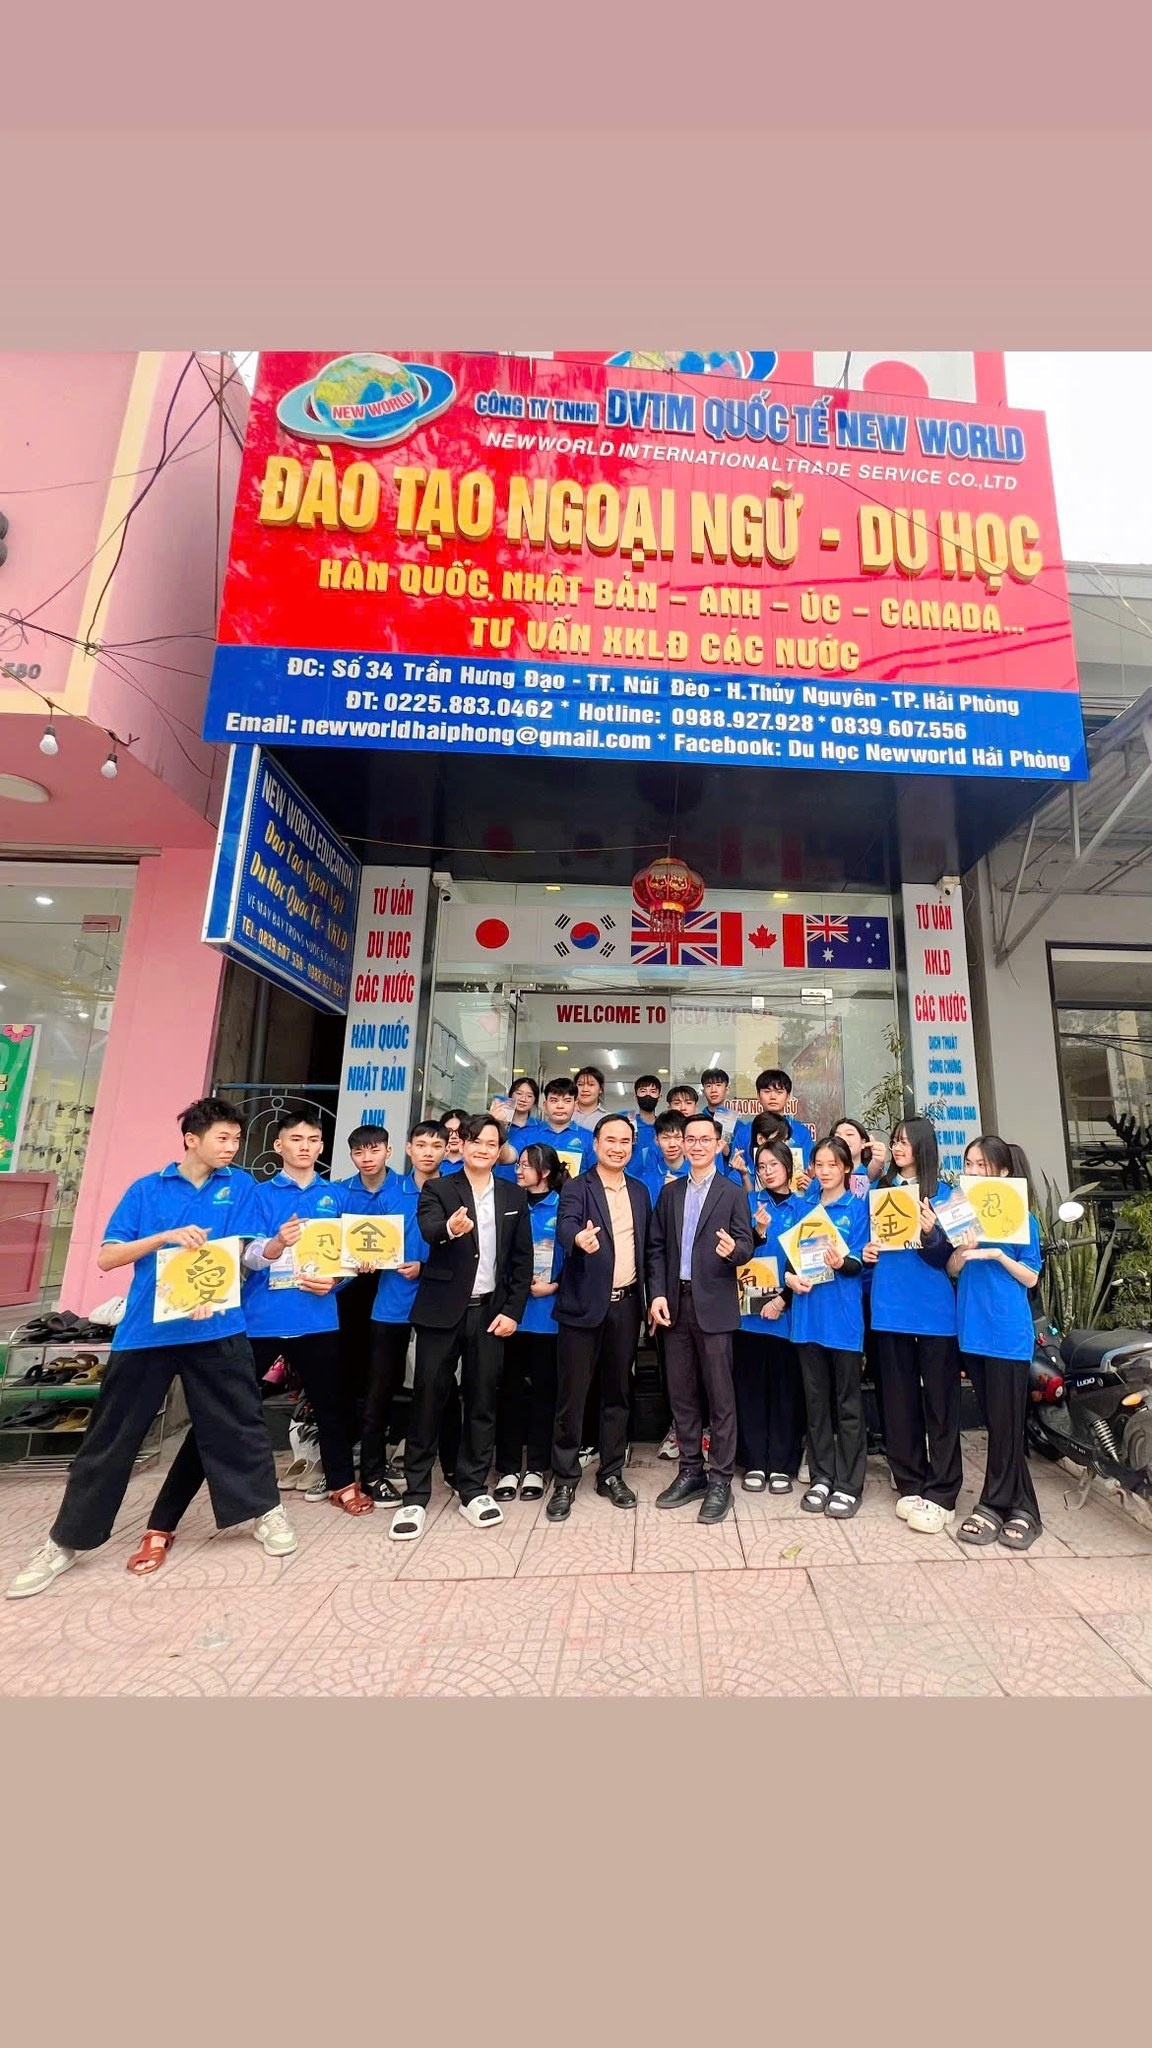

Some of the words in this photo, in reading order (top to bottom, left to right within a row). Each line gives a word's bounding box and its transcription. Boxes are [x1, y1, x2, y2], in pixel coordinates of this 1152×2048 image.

[332, 404, 367, 420] NEW
[370, 391, 414, 416] WORLD
[475, 390, 522, 418] CÔNG
[529, 397, 551, 420] TY
[554, 399, 598, 423] TNHH
[606, 386, 694, 433] DVTM
[703, 389, 788, 441] QUỐC
[792, 395, 829, 447] TẾ
[836, 409, 908, 454] NEW
[915, 414, 1026, 463] WORLD
[785, 459, 850, 478] TRADE
[859, 464, 941, 485] SERVICE
[947, 471, 1017, 491] CO.,LTD
[260, 444, 380, 533] ĐÀO
[394, 468, 495, 550] TẠO
[507, 475, 676, 572] NGOẠI
[690, 481, 804, 568] NGỮ
[820, 527, 840, 551] -
[859, 505, 930, 577] DU
[938, 511, 1043, 595] HỌC
[319, 554, 388, 592] HÀN
[400, 559, 494, 600] QUỐC,
[502, 570, 582, 610] NHẬT
[594, 572, 657, 613] BẢN
[699, 586, 761, 619] ANH
[801, 587, 840, 623] ÚC
[880, 599, 1024, 634] CANADA...
[470, 616, 515, 649] TƯ
[527, 613, 590, 654] VẤN
[603, 626, 688, 662] XKLĐ
[701, 628, 763, 666] CÁC
[776, 632, 859, 672] NƯỚC
[288, 658, 325, 676] ĐC:
[332, 656, 362, 679] Số
[366, 660, 393, 679] 34
[404, 660, 451, 683] Trần
[461, 666, 515, 689] Hưng
[525, 669, 565, 692] Đạo
[588, 674, 615, 691] TT.
[624, 675, 659, 695] Núi
[671, 678, 710, 698] Đèo
[803, 686, 876, 709] Nguyên
[924, 690, 954, 711] Hải
[960, 694, 1019, 716] Phòng
[346, 691, 378, 710] ĐT:
[384, 692, 554, 719] 0225.883.0462
[579, 702, 660, 724] Hotline:
[672, 708, 813, 732] 0988.927.928
[831, 716, 966, 739] 0839.607.556
[226, 713, 296, 734] Email:
[301, 719, 651, 750] newworldhaiphong@gmail.com
[674, 734, 781, 756] Facebook:
[789, 742, 814, 758] Du
[821, 742, 859, 764] Học
[866, 744, 966, 765] Newworld
[972, 745, 1003, 767] Hải
[1011, 749, 1070, 772] Phòng
[262, 771, 287, 818] NEW
[286, 797, 315, 851] WORLD
[315, 831, 354, 892] EDUCATION
[250, 851, 267, 883] Du
[373, 886, 389, 914] TƯ
[391, 878, 414, 915] VẤN
[916, 902, 930, 930] TƯ
[931, 894, 952, 930] VẤN
[242, 916, 257, 939] TEL:
[367, 931, 383, 958] DU
[387, 931, 411, 964] HỌC
[355, 968, 379, 1003] CÁC
[382, 969, 415, 1003] NƯỚC
[556, 1005, 640, 1024] WELCOME
[646, 1005, 667, 1024] TO
[915, 988, 938, 1022] CÁC
[938, 988, 967, 1022] NƯỚC
[351, 1019, 375, 1049] HÀN
[379, 1016, 409, 1052] QUỐC
[347, 1061, 378, 1097] NHẬT
[381, 1056, 406, 1092] BẢN
[875, 1192, 912, 1238] 金
[350, 1221, 386, 1252] 金
